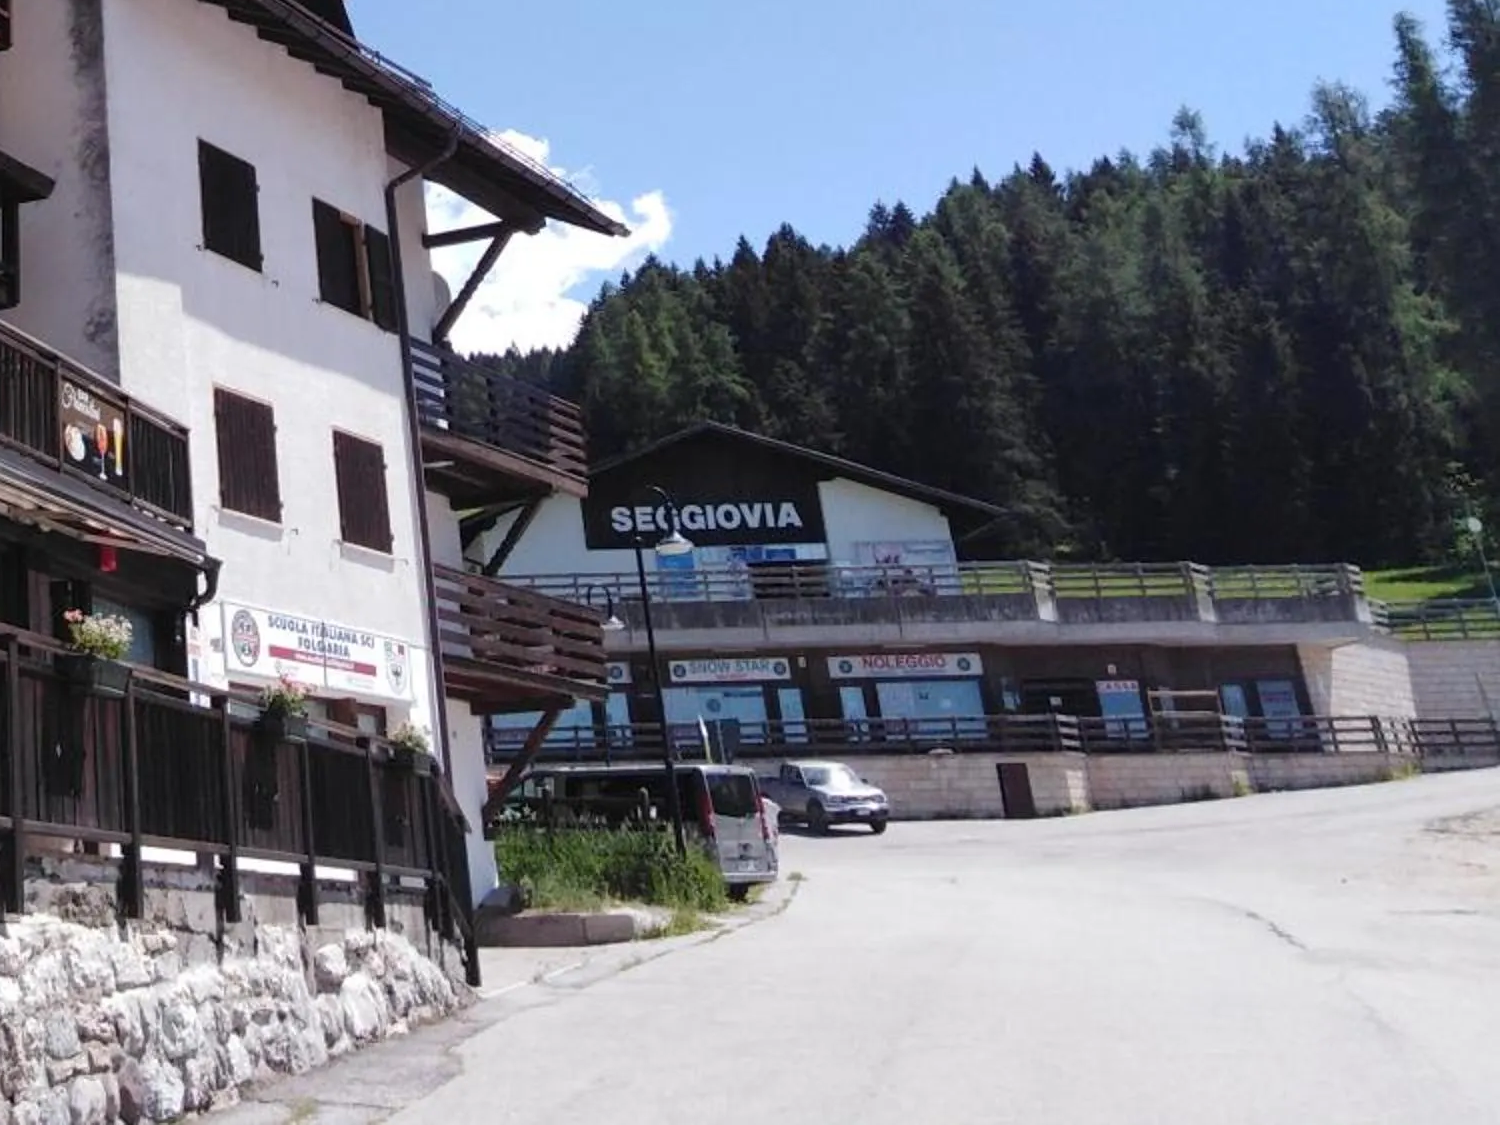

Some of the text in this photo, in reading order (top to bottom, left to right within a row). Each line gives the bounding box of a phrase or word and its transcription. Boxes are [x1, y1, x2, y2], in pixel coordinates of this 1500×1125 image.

[611, 502, 803, 532] SEGGIOVIA
[268, 614, 308, 634] SCUOLA
[360, 634, 375, 649] SCI
[298, 636, 350, 658] FOLGARIA
[862, 655, 946, 670] NOLEGGIO
